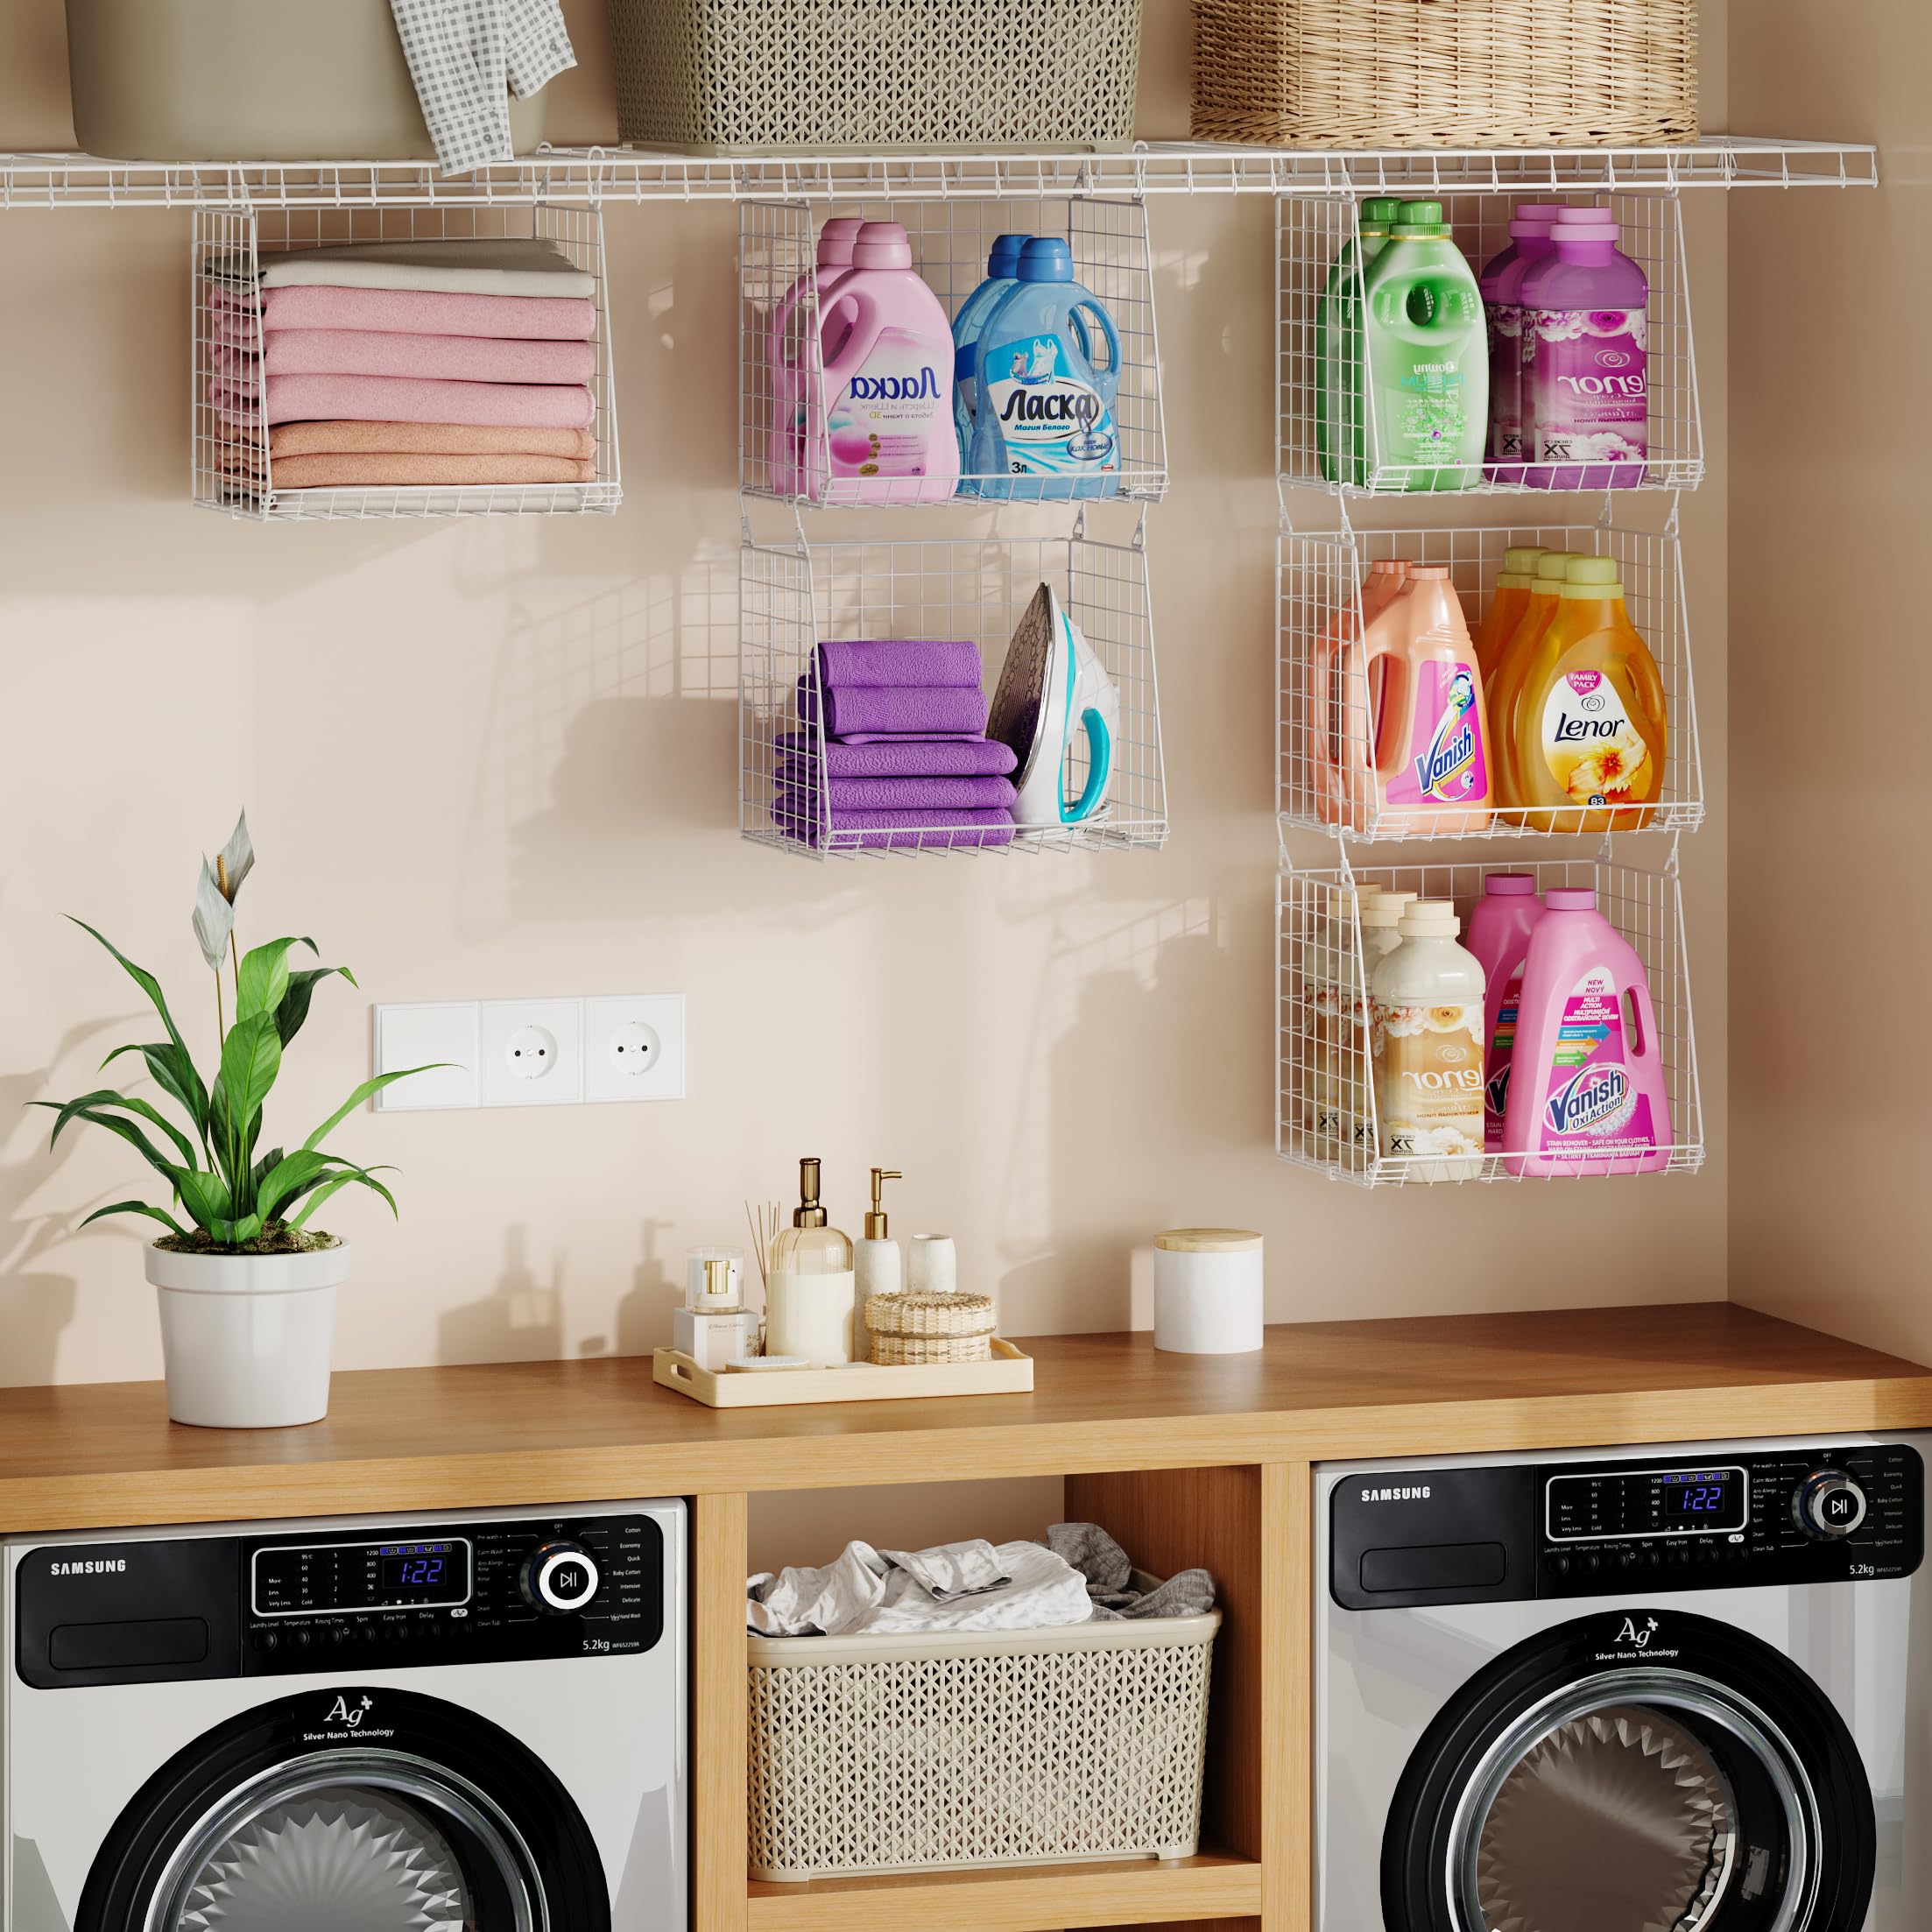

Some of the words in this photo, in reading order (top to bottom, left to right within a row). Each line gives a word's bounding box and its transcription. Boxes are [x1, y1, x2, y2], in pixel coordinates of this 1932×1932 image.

[1000, 389, 1092, 421] Ласка
[1012, 462, 1027, 474] 3л
[1554, 713, 1625, 743] Lenor
[1415, 722, 1473, 791] Vanish
[1550, 1067, 1622, 1132] Vanish
[1572, 1111, 1589, 1129] Oxi
[1590, 1096, 1621, 1120] Action
[1361, 1486, 1431, 1502] SAMSUNG
[1683, 1487, 1721, 1510] 1:22
[50, 1559, 126, 1576] SAMSUNG
[401, 1559, 443, 1583] 1:22
[1850, 1564, 1874, 1576] 5.2kg
[582, 1639, 610, 1652] 5.2kg
[1638, 1649, 1679, 1658] Technology
[350, 1728, 394, 1738] Technology
